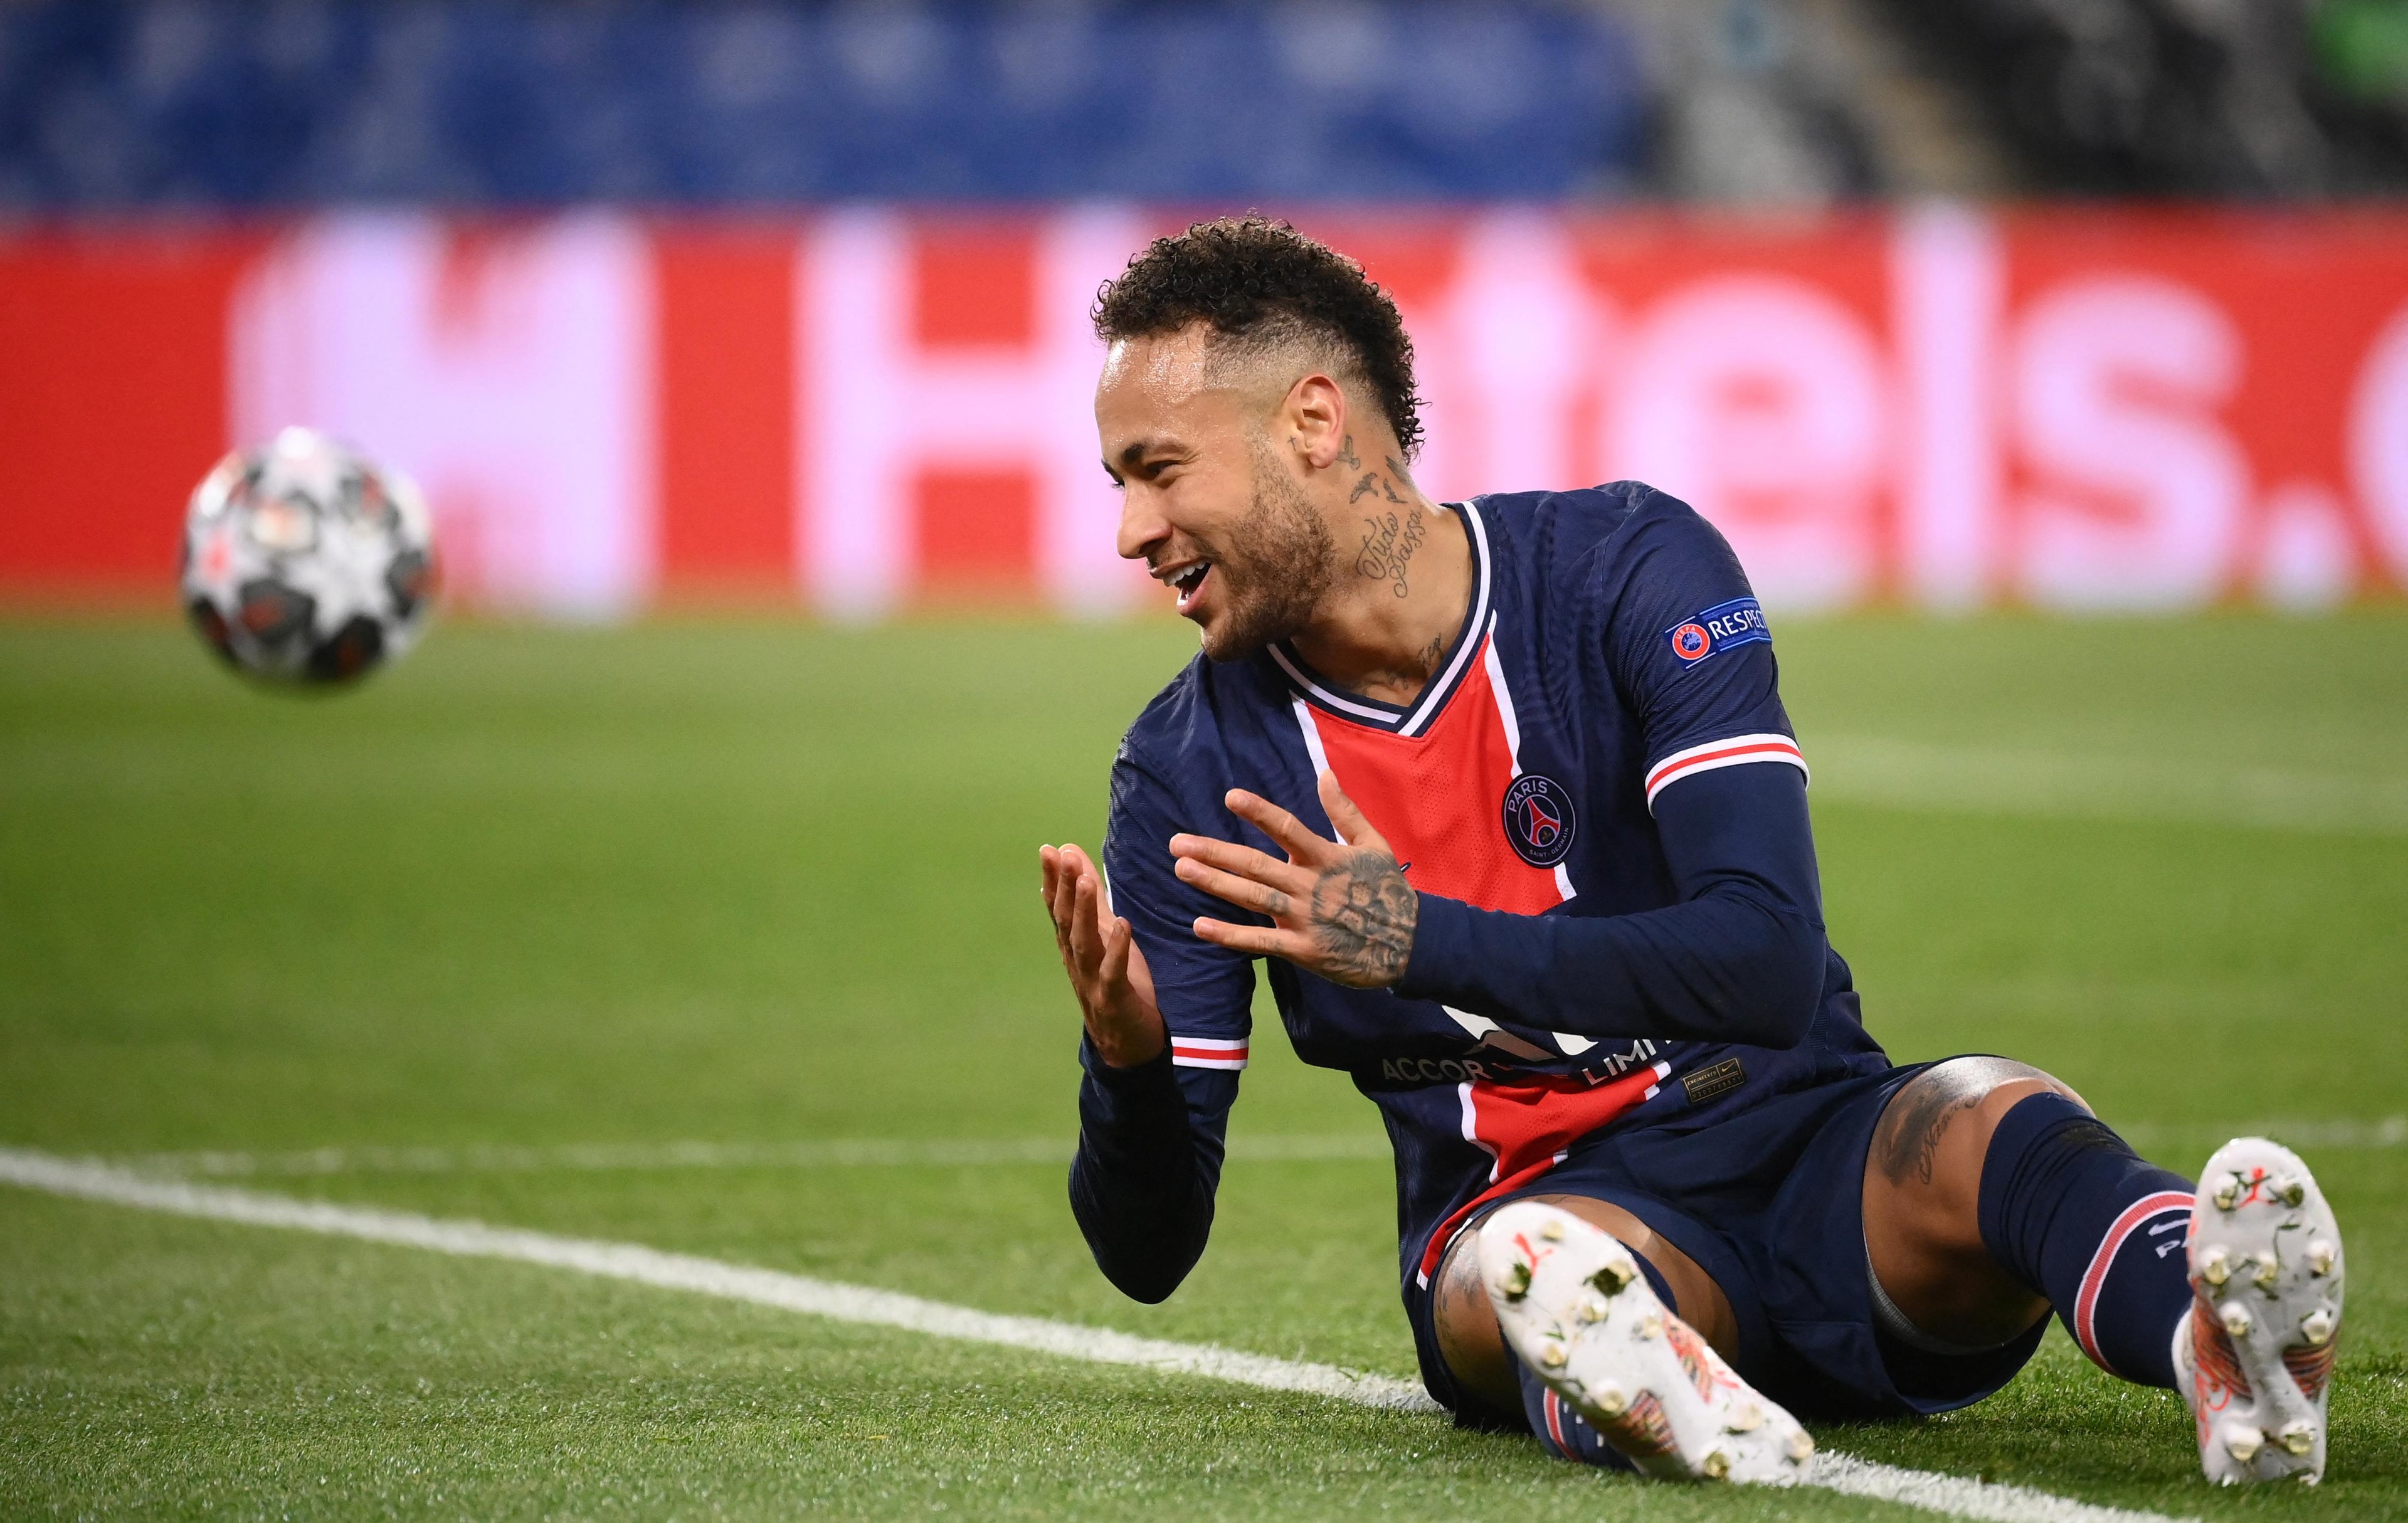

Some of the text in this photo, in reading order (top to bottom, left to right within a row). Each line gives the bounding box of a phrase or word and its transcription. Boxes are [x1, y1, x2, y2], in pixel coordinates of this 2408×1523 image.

[795, 204, 2408, 618] Htels.
[1676, 625, 1696, 639] UEFA
[1508, 780, 1548, 813] PARIS
[1382, 1057, 1494, 1082] ACCOR
